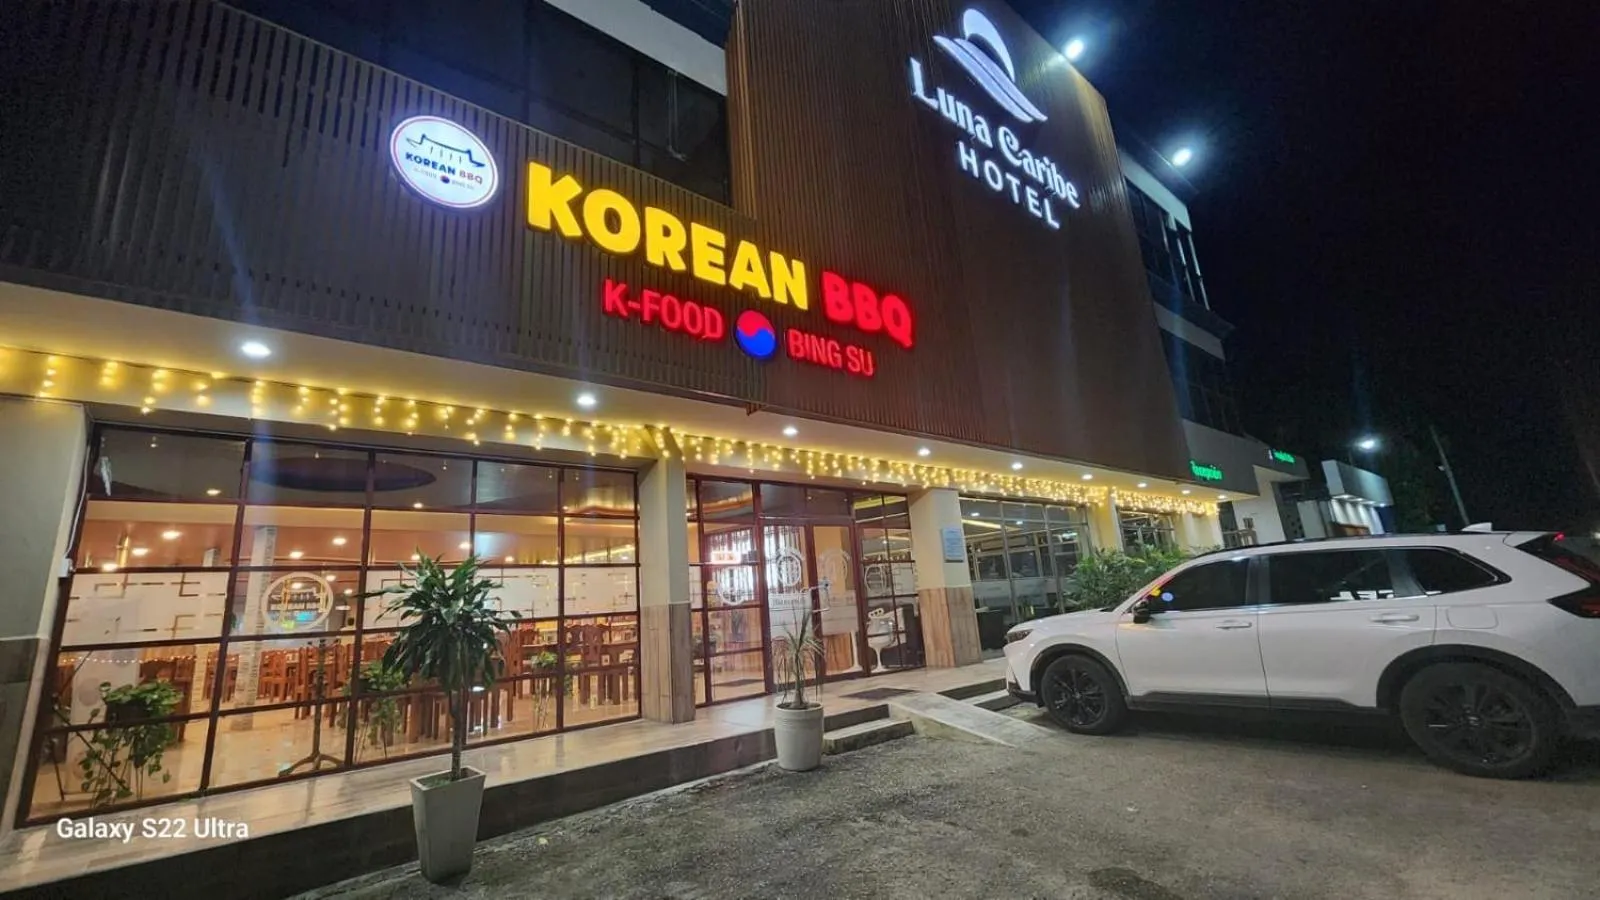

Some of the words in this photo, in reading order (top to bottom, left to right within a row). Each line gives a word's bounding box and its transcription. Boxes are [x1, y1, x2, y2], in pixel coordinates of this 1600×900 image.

[405, 151, 456, 175] KOREAN
[459, 169, 483, 185] BBQ
[910, 57, 993, 148] Luna
[998, 126, 1081, 209] Caribe
[958, 140, 1060, 230] HOTEL
[527, 161, 809, 311] KOREAN
[821, 270, 913, 349] BBQ
[603, 278, 725, 341] K-FOOD
[786, 328, 843, 365] BING
[847, 344, 875, 377] SU
